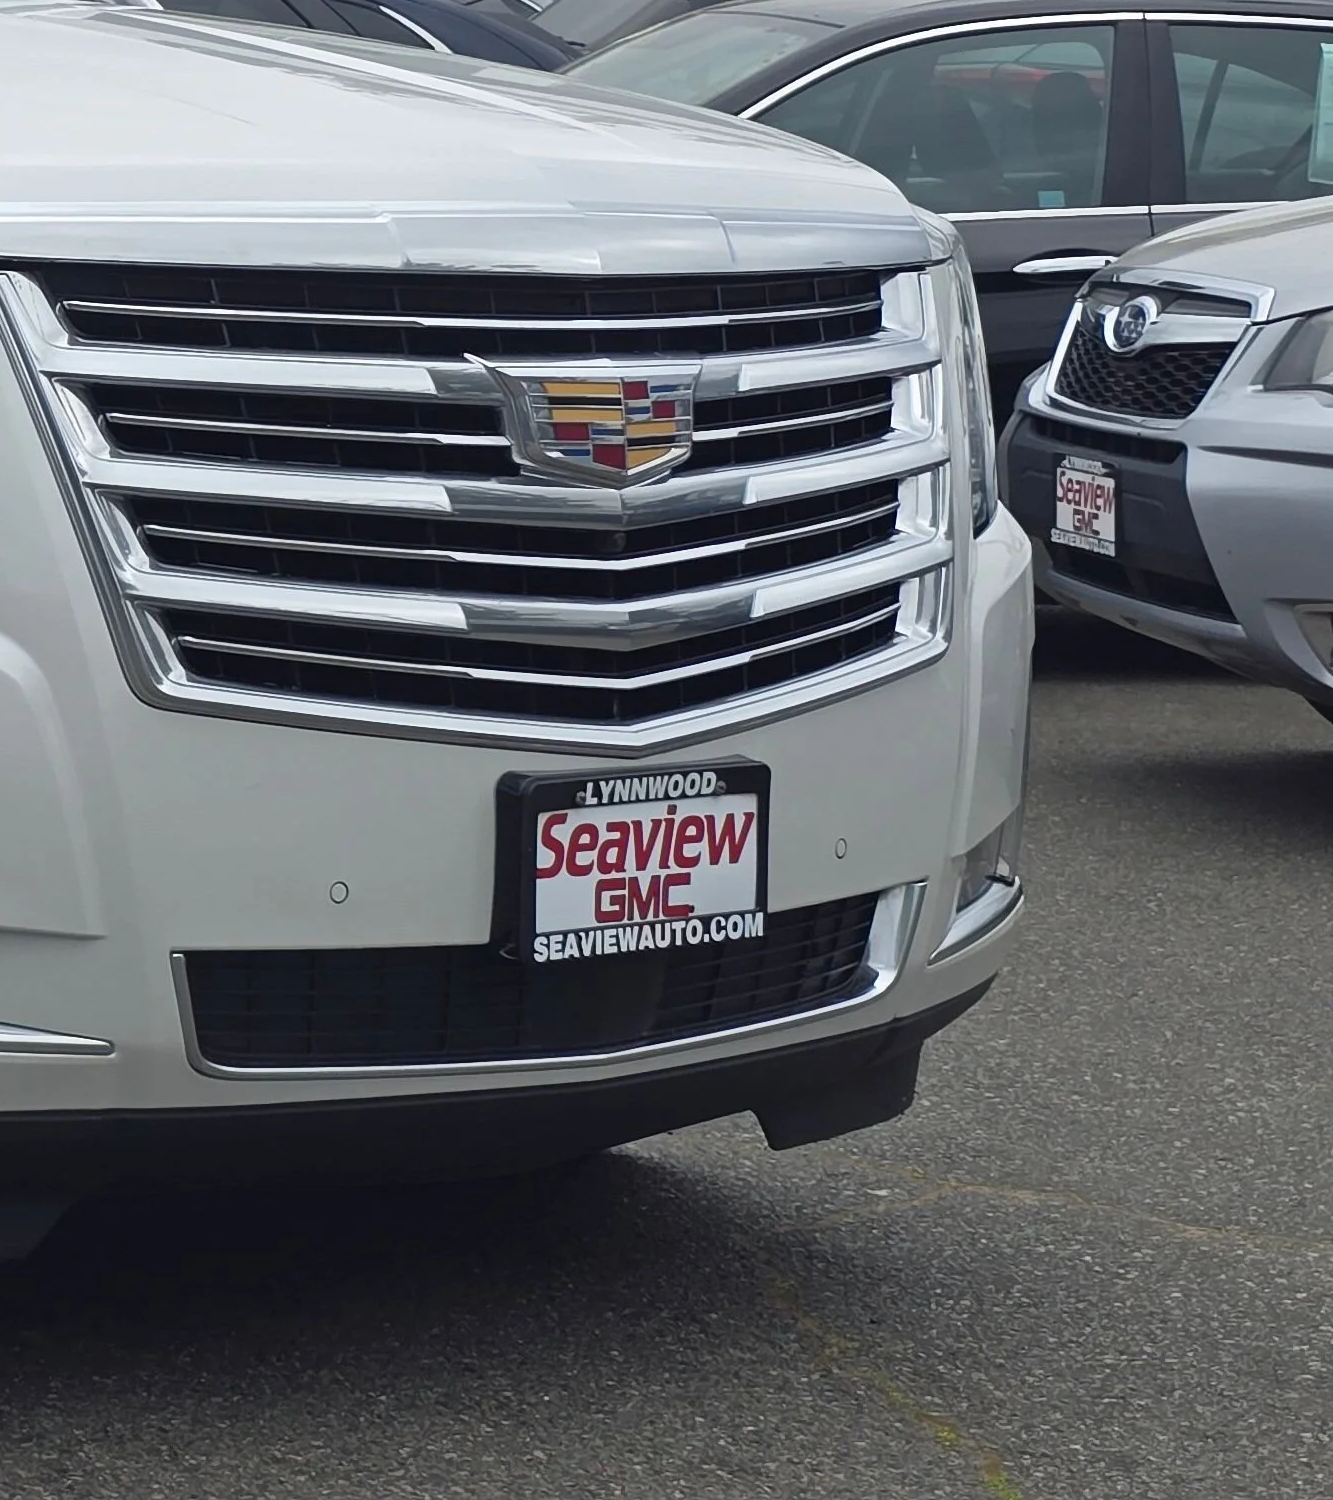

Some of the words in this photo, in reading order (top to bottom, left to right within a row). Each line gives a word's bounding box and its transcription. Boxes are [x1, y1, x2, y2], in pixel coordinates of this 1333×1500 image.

[1056, 470, 1115, 514] Seaview
[1073, 507, 1100, 536] GMC
[584, 771, 717, 805] LYNNWOOD
[536, 804, 755, 879] Seaview
[594, 872, 693, 924] GMC
[534, 912, 764, 963] SEAVIEWAUTO.COM
